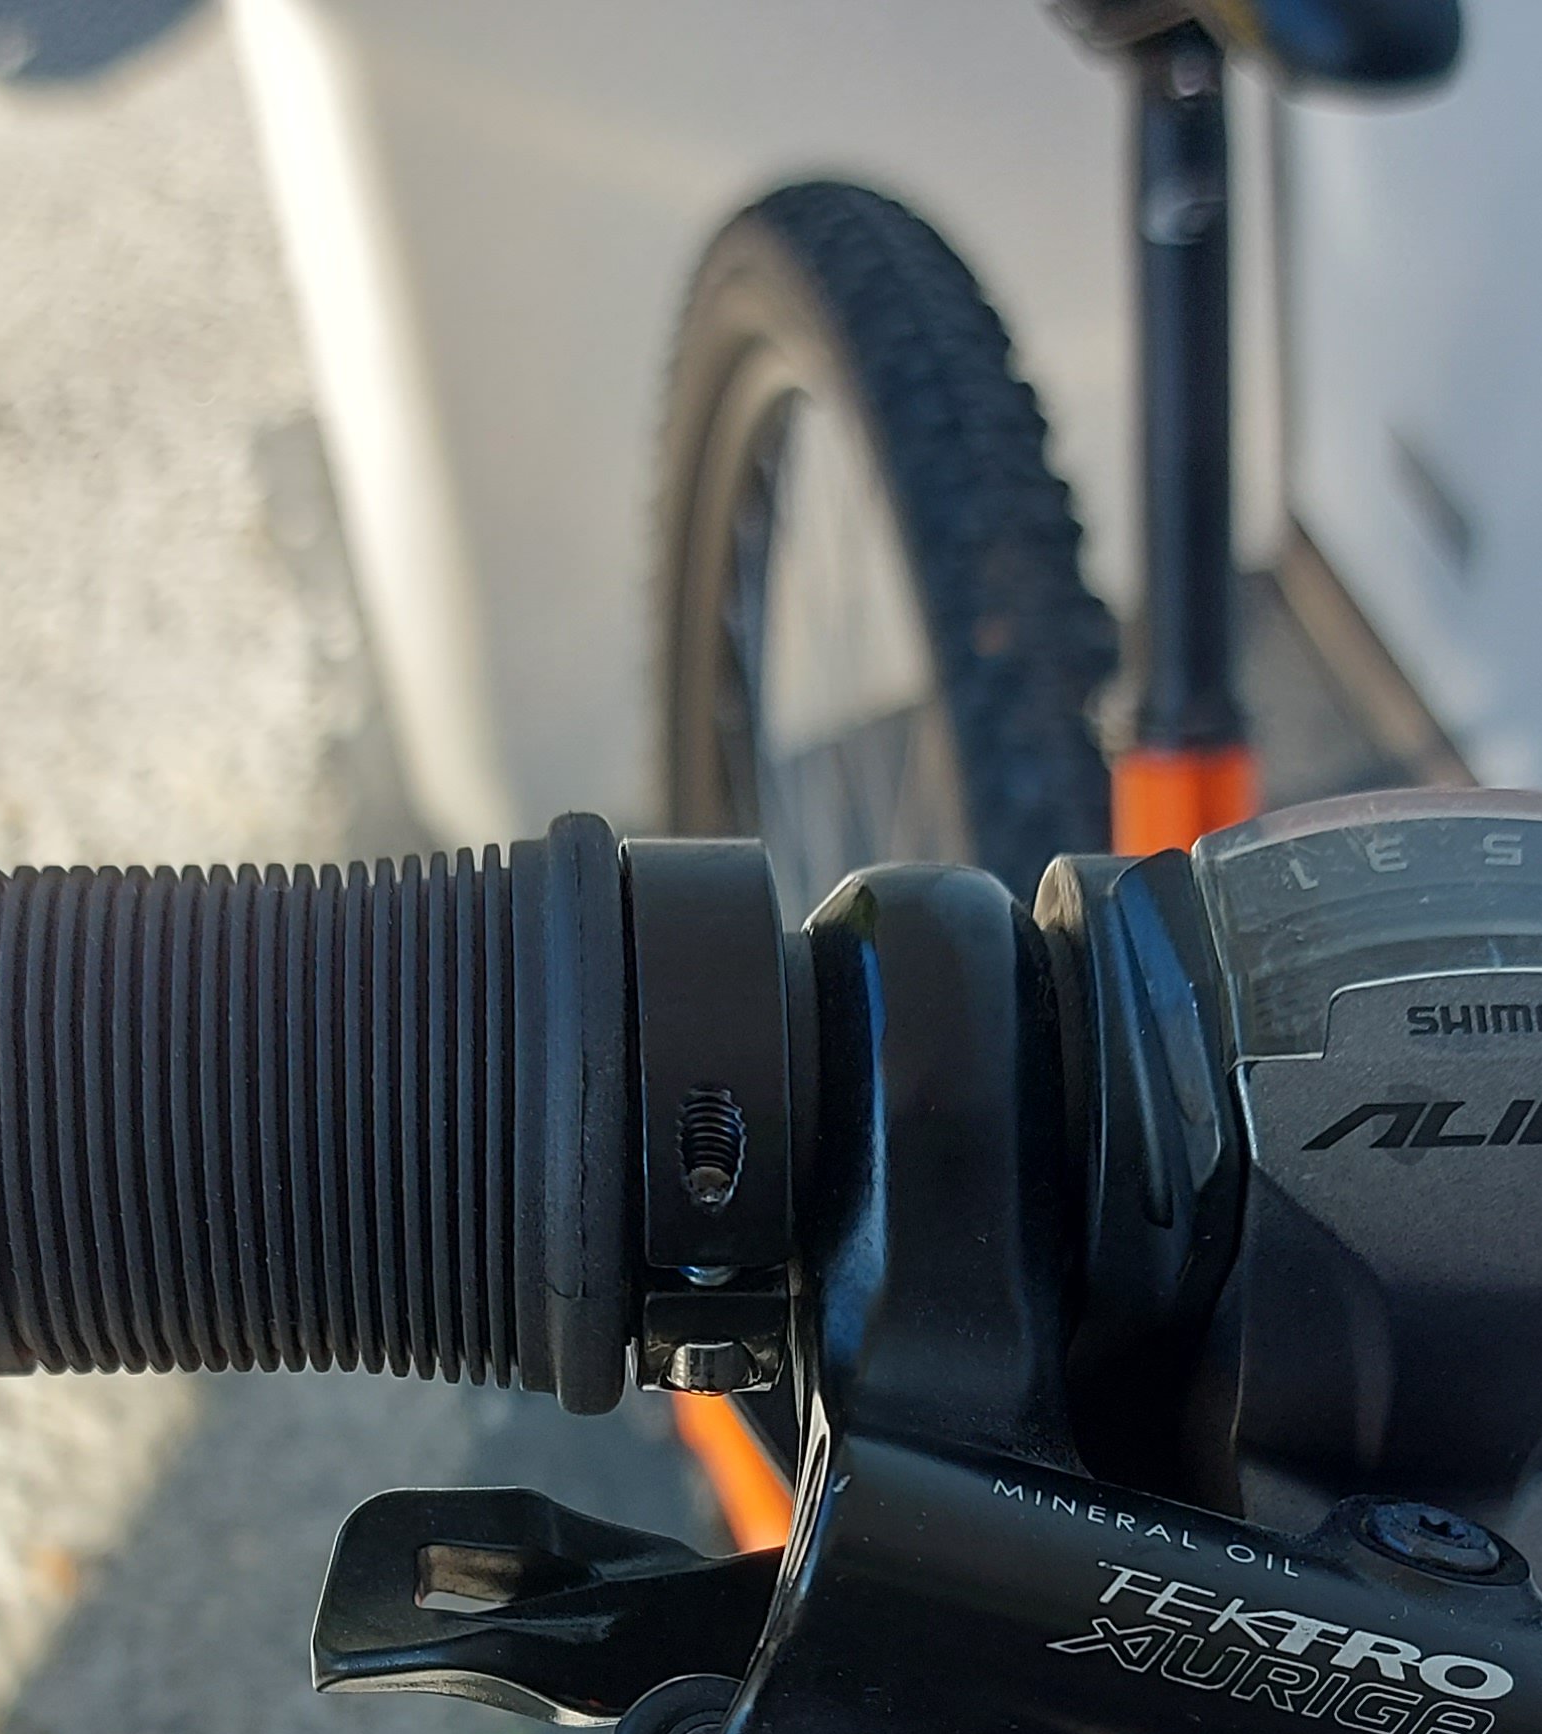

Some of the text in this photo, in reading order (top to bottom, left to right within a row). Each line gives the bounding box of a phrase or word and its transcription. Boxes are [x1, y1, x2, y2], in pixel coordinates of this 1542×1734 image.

[1364, 832, 1409, 874] 3
[1481, 832, 1523, 867] 5
[992, 1477, 1301, 1580] MINERAL OIL
[1096, 1559, 1515, 1701] TEKTRO
